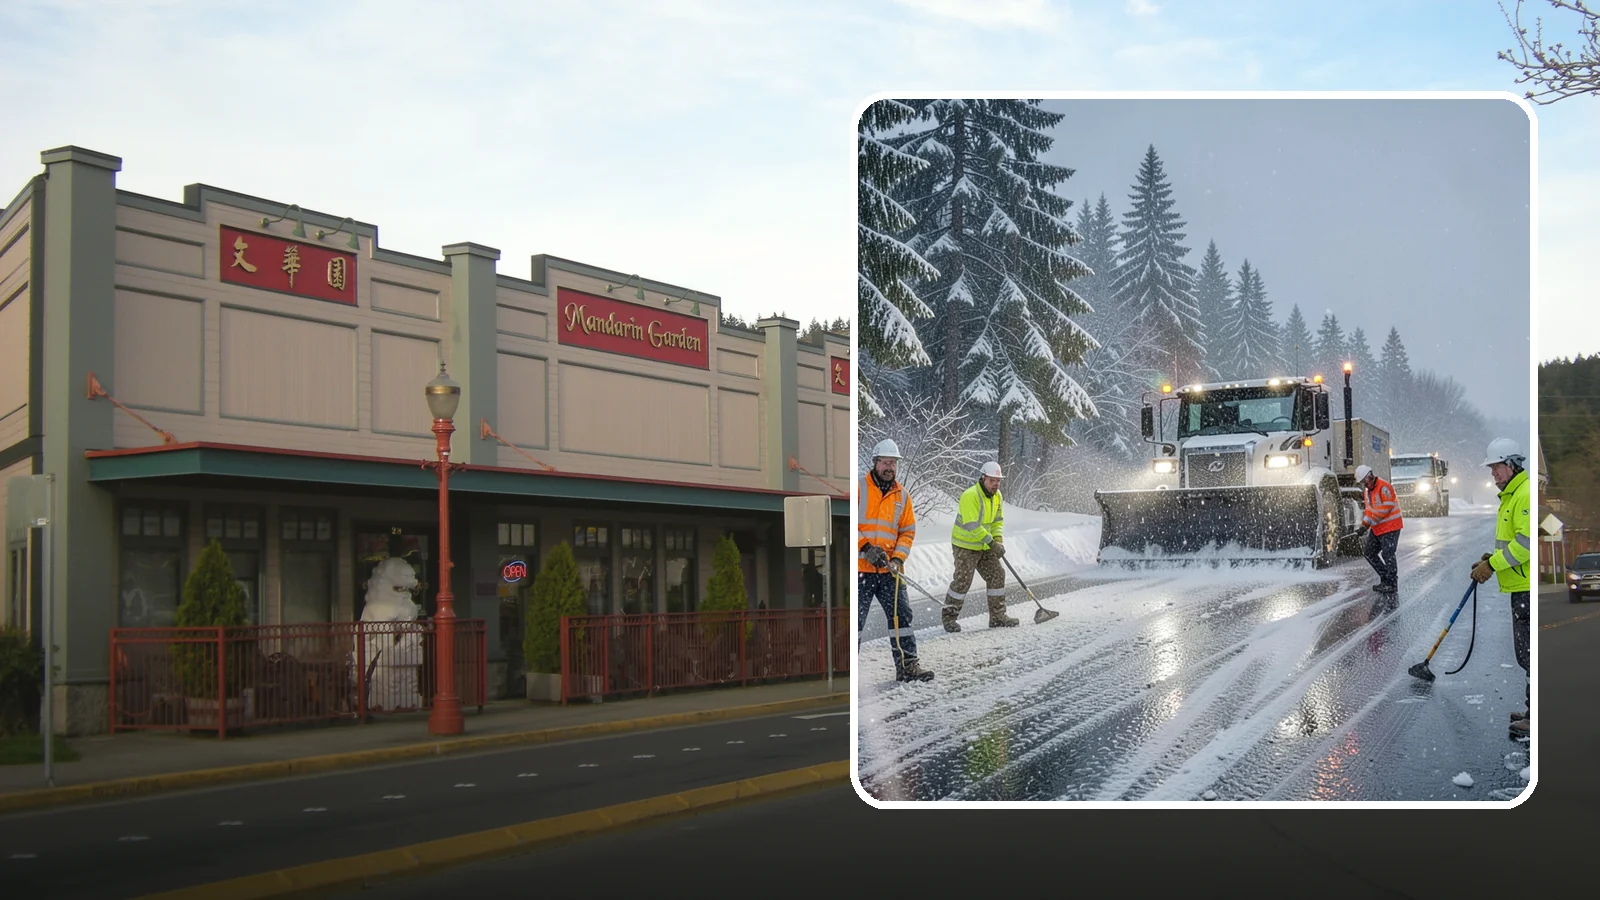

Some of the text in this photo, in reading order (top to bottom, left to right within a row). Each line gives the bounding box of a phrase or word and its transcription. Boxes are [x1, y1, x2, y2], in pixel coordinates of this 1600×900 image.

[564, 302, 702, 352] Mandarin Garden
[503, 565, 527, 578] OPEN
